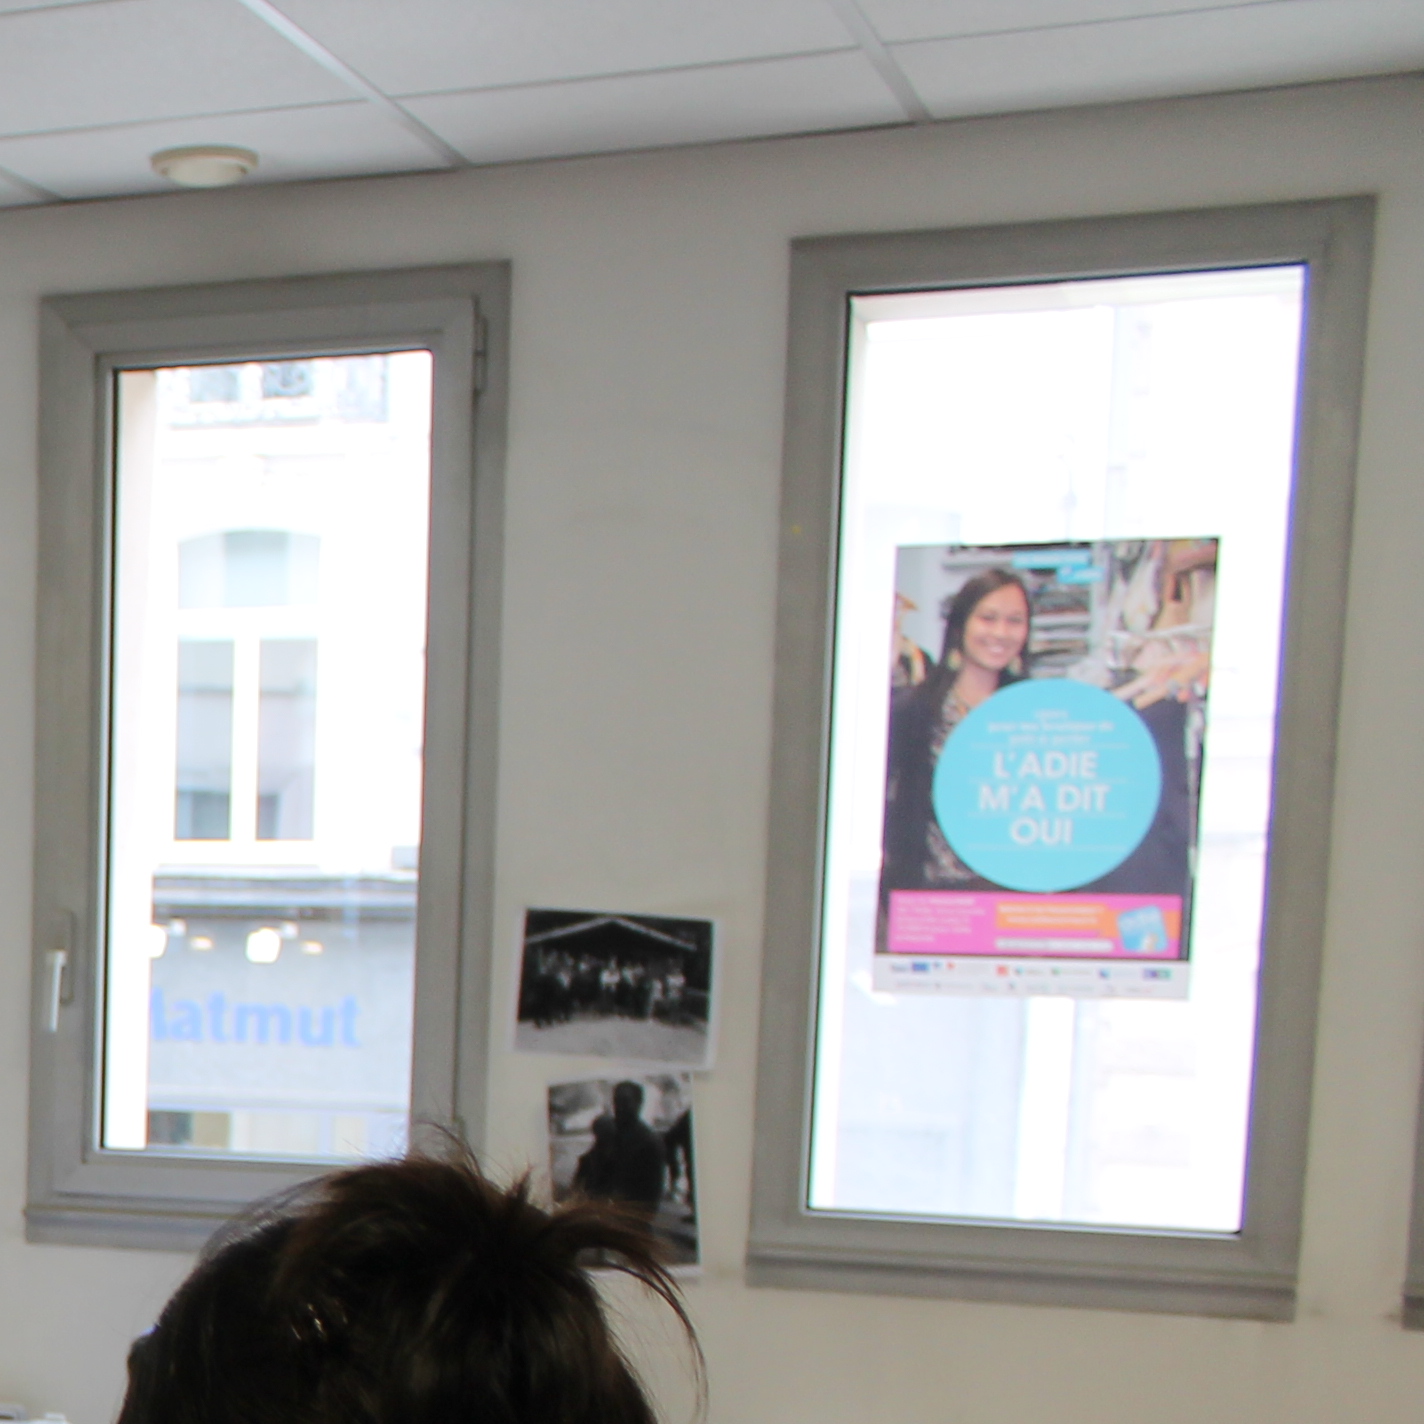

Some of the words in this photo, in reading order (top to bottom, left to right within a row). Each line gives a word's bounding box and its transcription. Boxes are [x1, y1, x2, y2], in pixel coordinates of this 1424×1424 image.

[993, 750, 1100, 779] L'ADIE
[978, 783, 1046, 812] M'A
[1057, 784, 1112, 812] DIT
[1010, 816, 1074, 845] OUI
